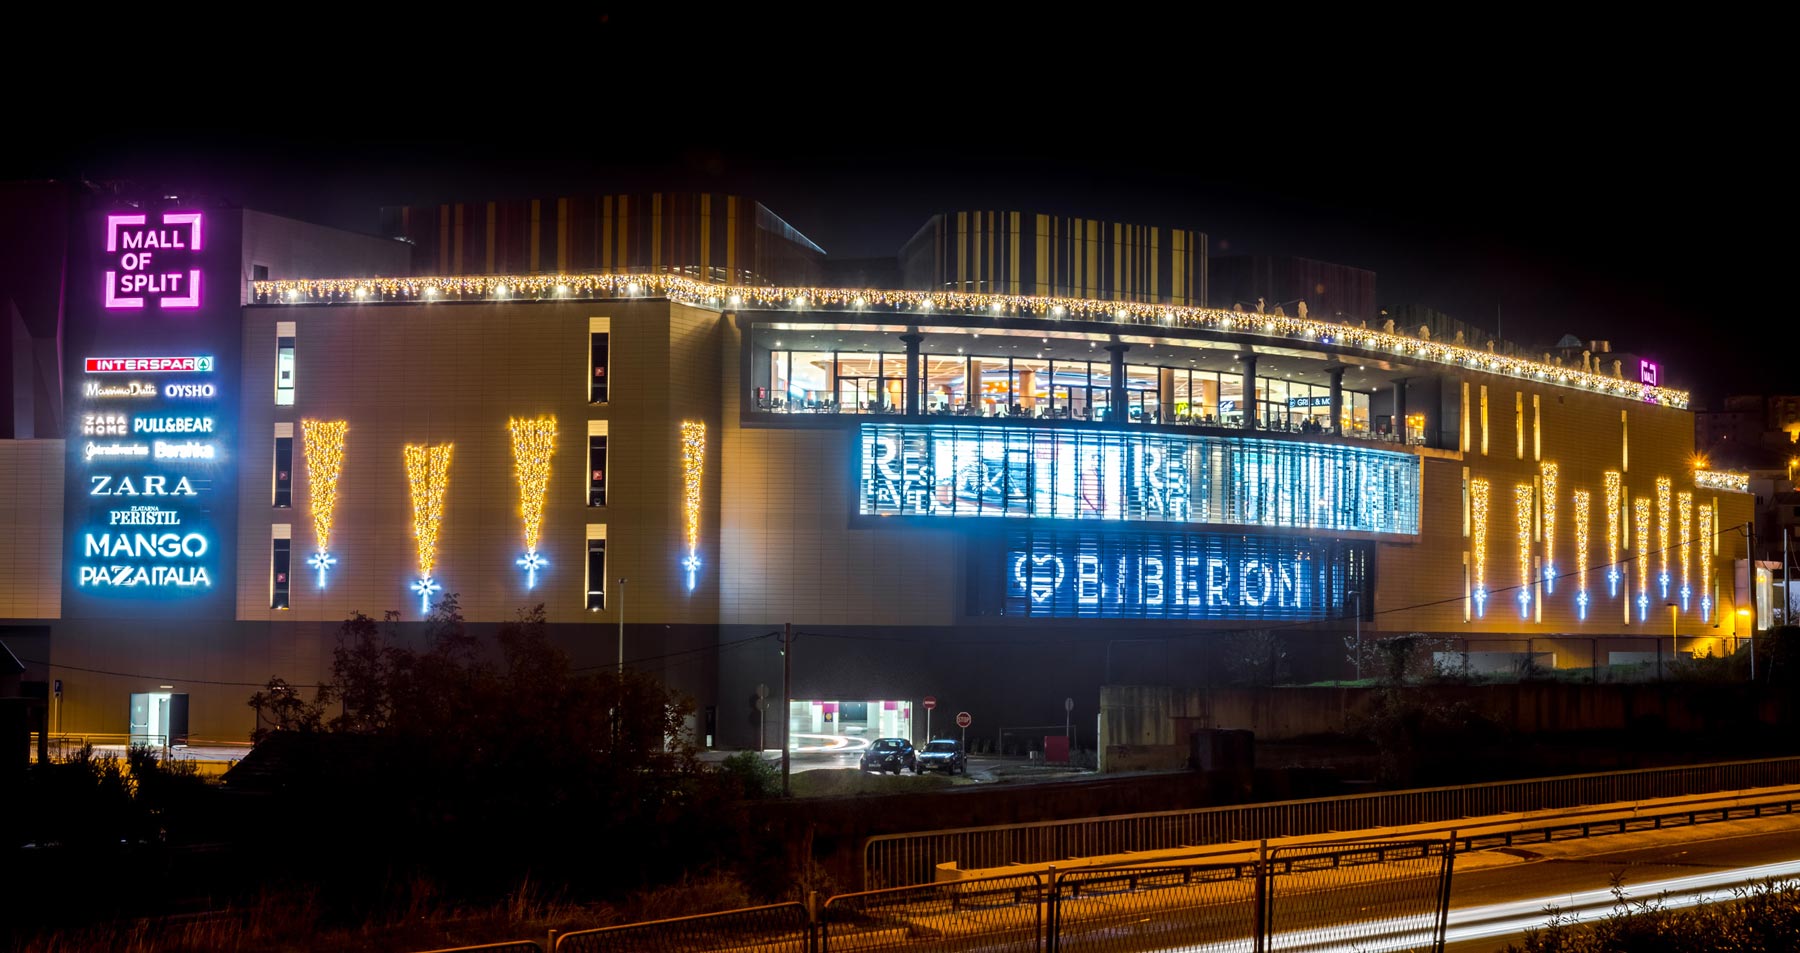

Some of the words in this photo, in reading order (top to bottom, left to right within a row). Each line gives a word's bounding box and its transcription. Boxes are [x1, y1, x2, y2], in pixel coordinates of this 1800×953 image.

[122, 230, 184, 249] MALL
[121, 253, 152, 270] OF
[121, 274, 182, 292] SPLIT
[97, 359, 194, 371] INTERSPAR
[165, 384, 214, 397] OYSHO
[86, 416, 126, 425] ZARA
[134, 418, 213, 433] PULL&BEAR
[85, 425, 127, 434] HOME
[90, 476, 198, 496] ZARA
[109, 511, 181, 525] PERISTIL
[85, 533, 208, 557] MANGO
[1074, 555, 1301, 608] BIBERON
